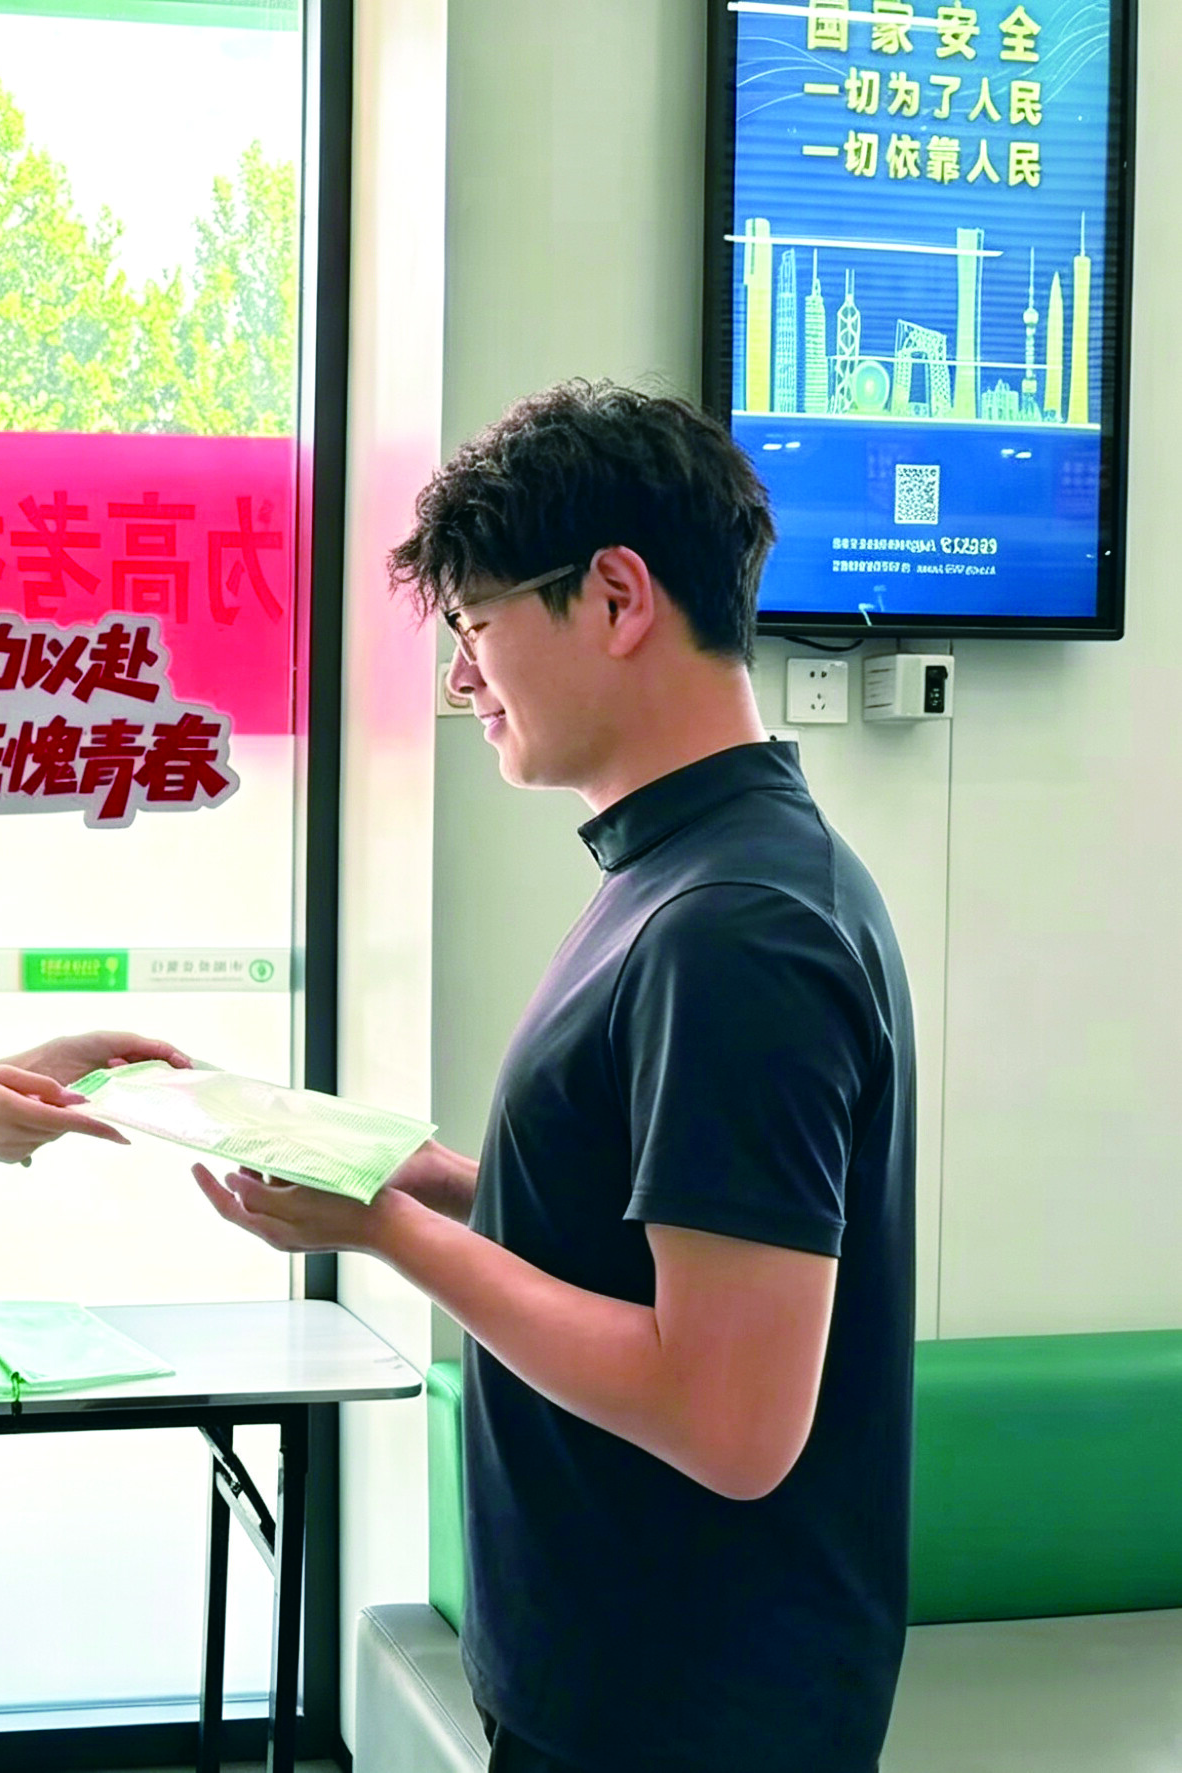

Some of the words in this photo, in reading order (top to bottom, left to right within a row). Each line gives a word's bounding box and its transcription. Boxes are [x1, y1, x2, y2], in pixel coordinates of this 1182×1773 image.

[807, 0, 1042, 63] 国家安全
[803, 67, 1043, 126] 一切为了人民
[802, 130, 1042, 188] 一切依靠人民
